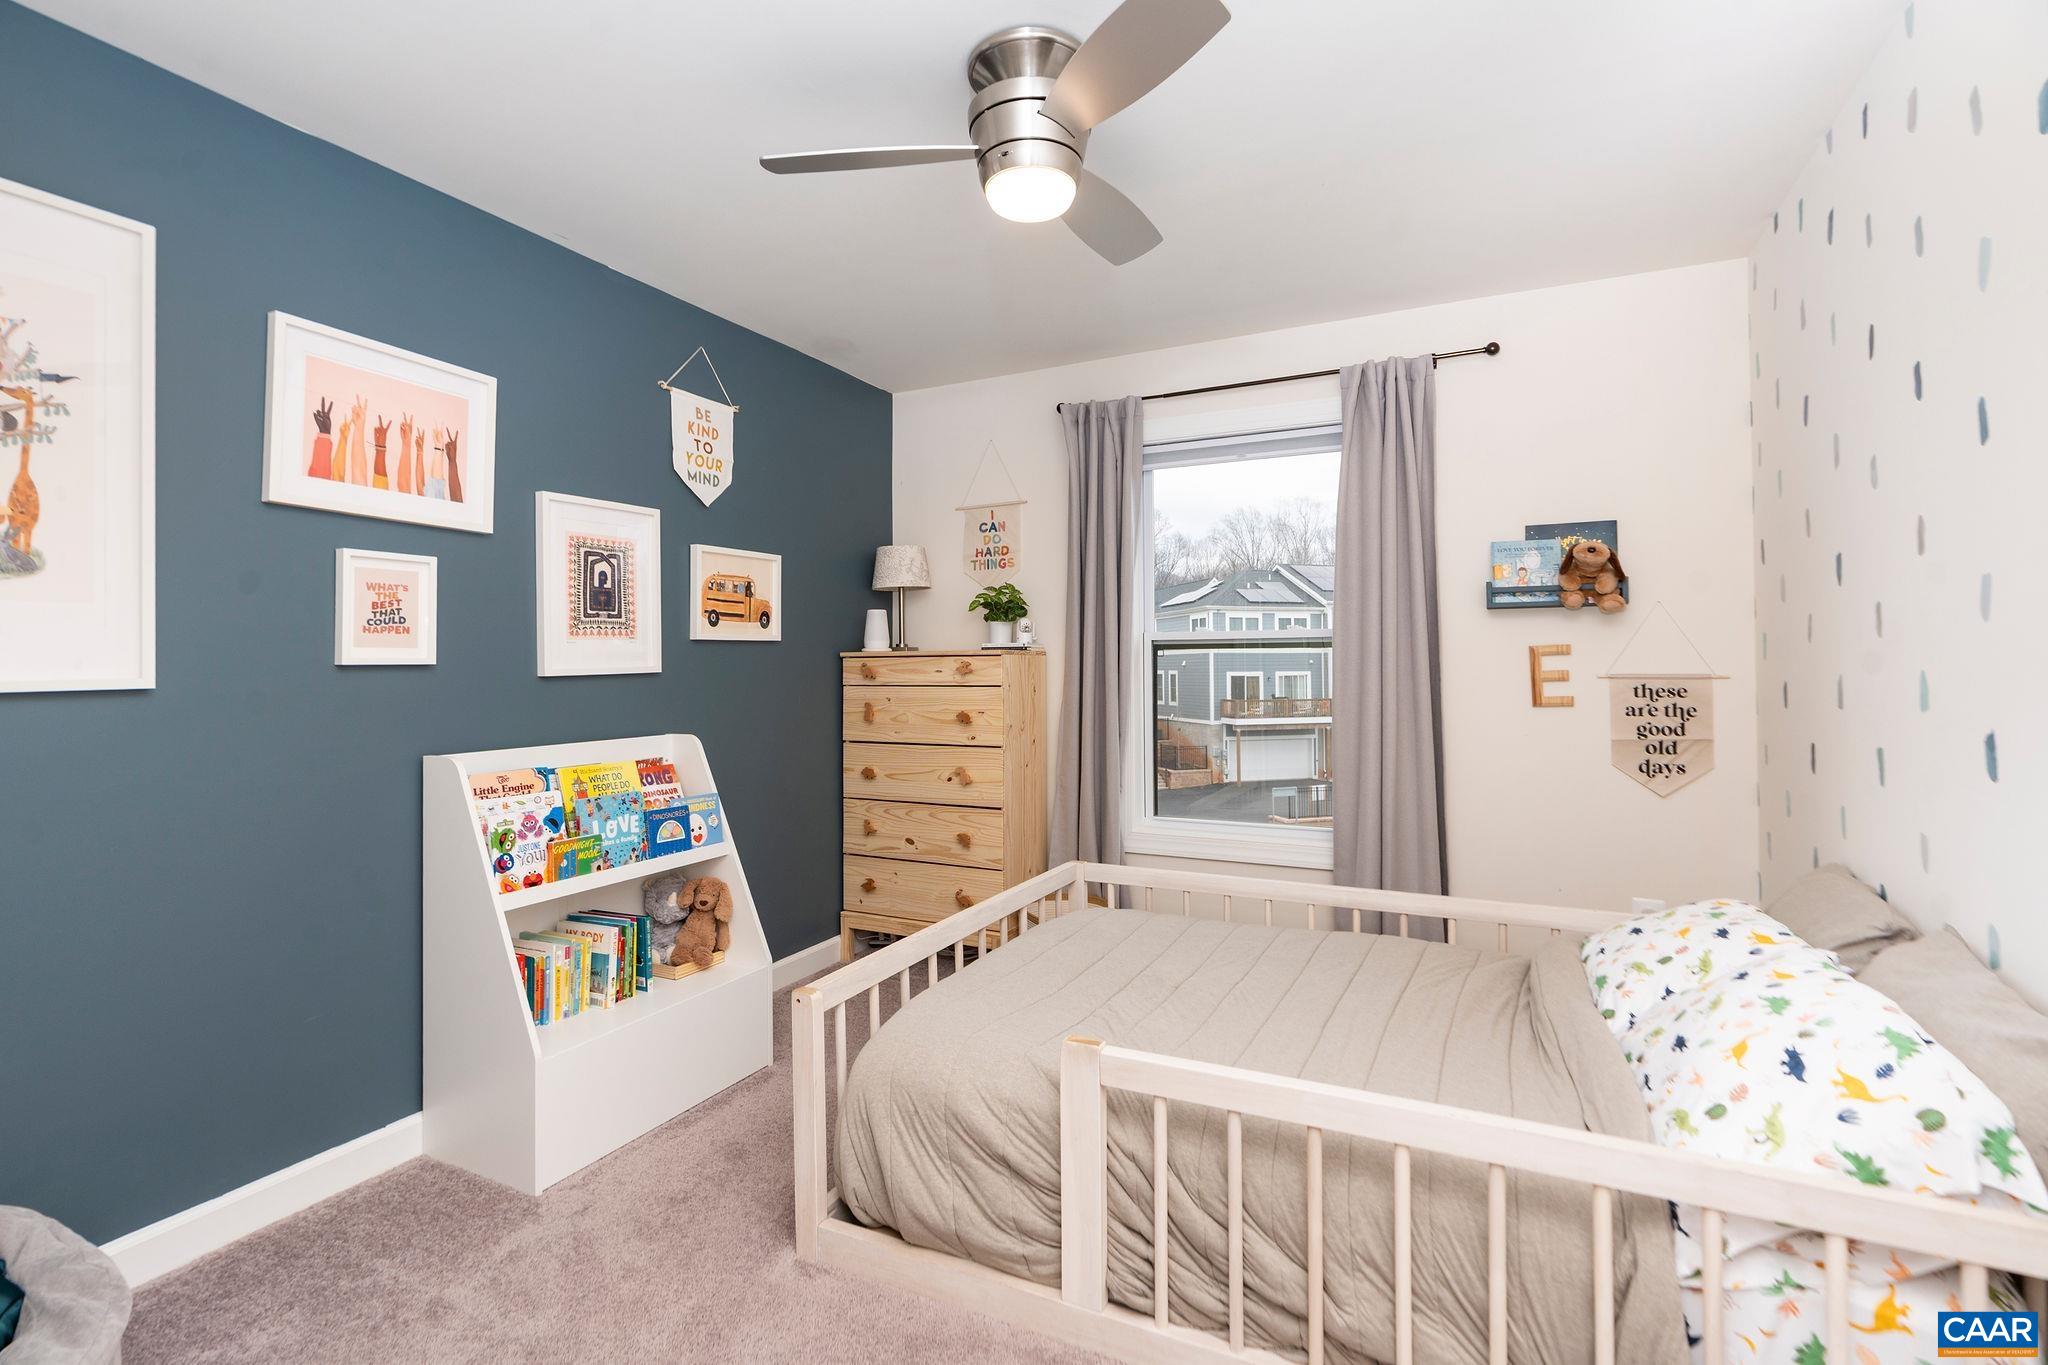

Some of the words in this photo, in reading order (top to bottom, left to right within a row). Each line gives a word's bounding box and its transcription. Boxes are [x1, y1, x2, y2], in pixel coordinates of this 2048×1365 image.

[695, 407, 711, 423] BE
[687, 421, 719, 440] KIND
[693, 438, 713, 454] TO
[686, 451, 723, 472] YOUR
[687, 470, 720, 487] MIND
[990, 510, 994, 520] I
[979, 521, 1006, 533] CAN
[983, 534, 1002, 545] DO
[975, 545, 1009, 558] HARD
[970, 557, 1015, 571] THINGS
[366, 582, 409, 592] WHAT'S
[376, 591, 399, 601] THE
[371, 599, 402, 610] BEST
[371, 608, 402, 618] THAT
[367, 616, 406, 626] COULD
[362, 625, 410, 635] HAPPEN
[1529, 644, 1574, 707] E
[1632, 683, 1688, 703] these
[1625, 703, 1659, 718] are
[1664, 703, 1698, 723] the
[1636, 721, 1686, 740] good
[1645, 739, 1678, 756] old
[1638, 759, 1686, 779] days
[588, 773, 610, 783] WHAT
[612, 772, 623, 781] DO
[473, 786, 500, 796] Little
[502, 783, 535, 795] Engine
[592, 782, 619, 792] PEOPLE
[620, 781, 630, 789] DO
[642, 788, 678, 799] DINOSAUR
[592, 813, 639, 840] LOVE
[553, 838, 598, 855] GOODNIGHT
